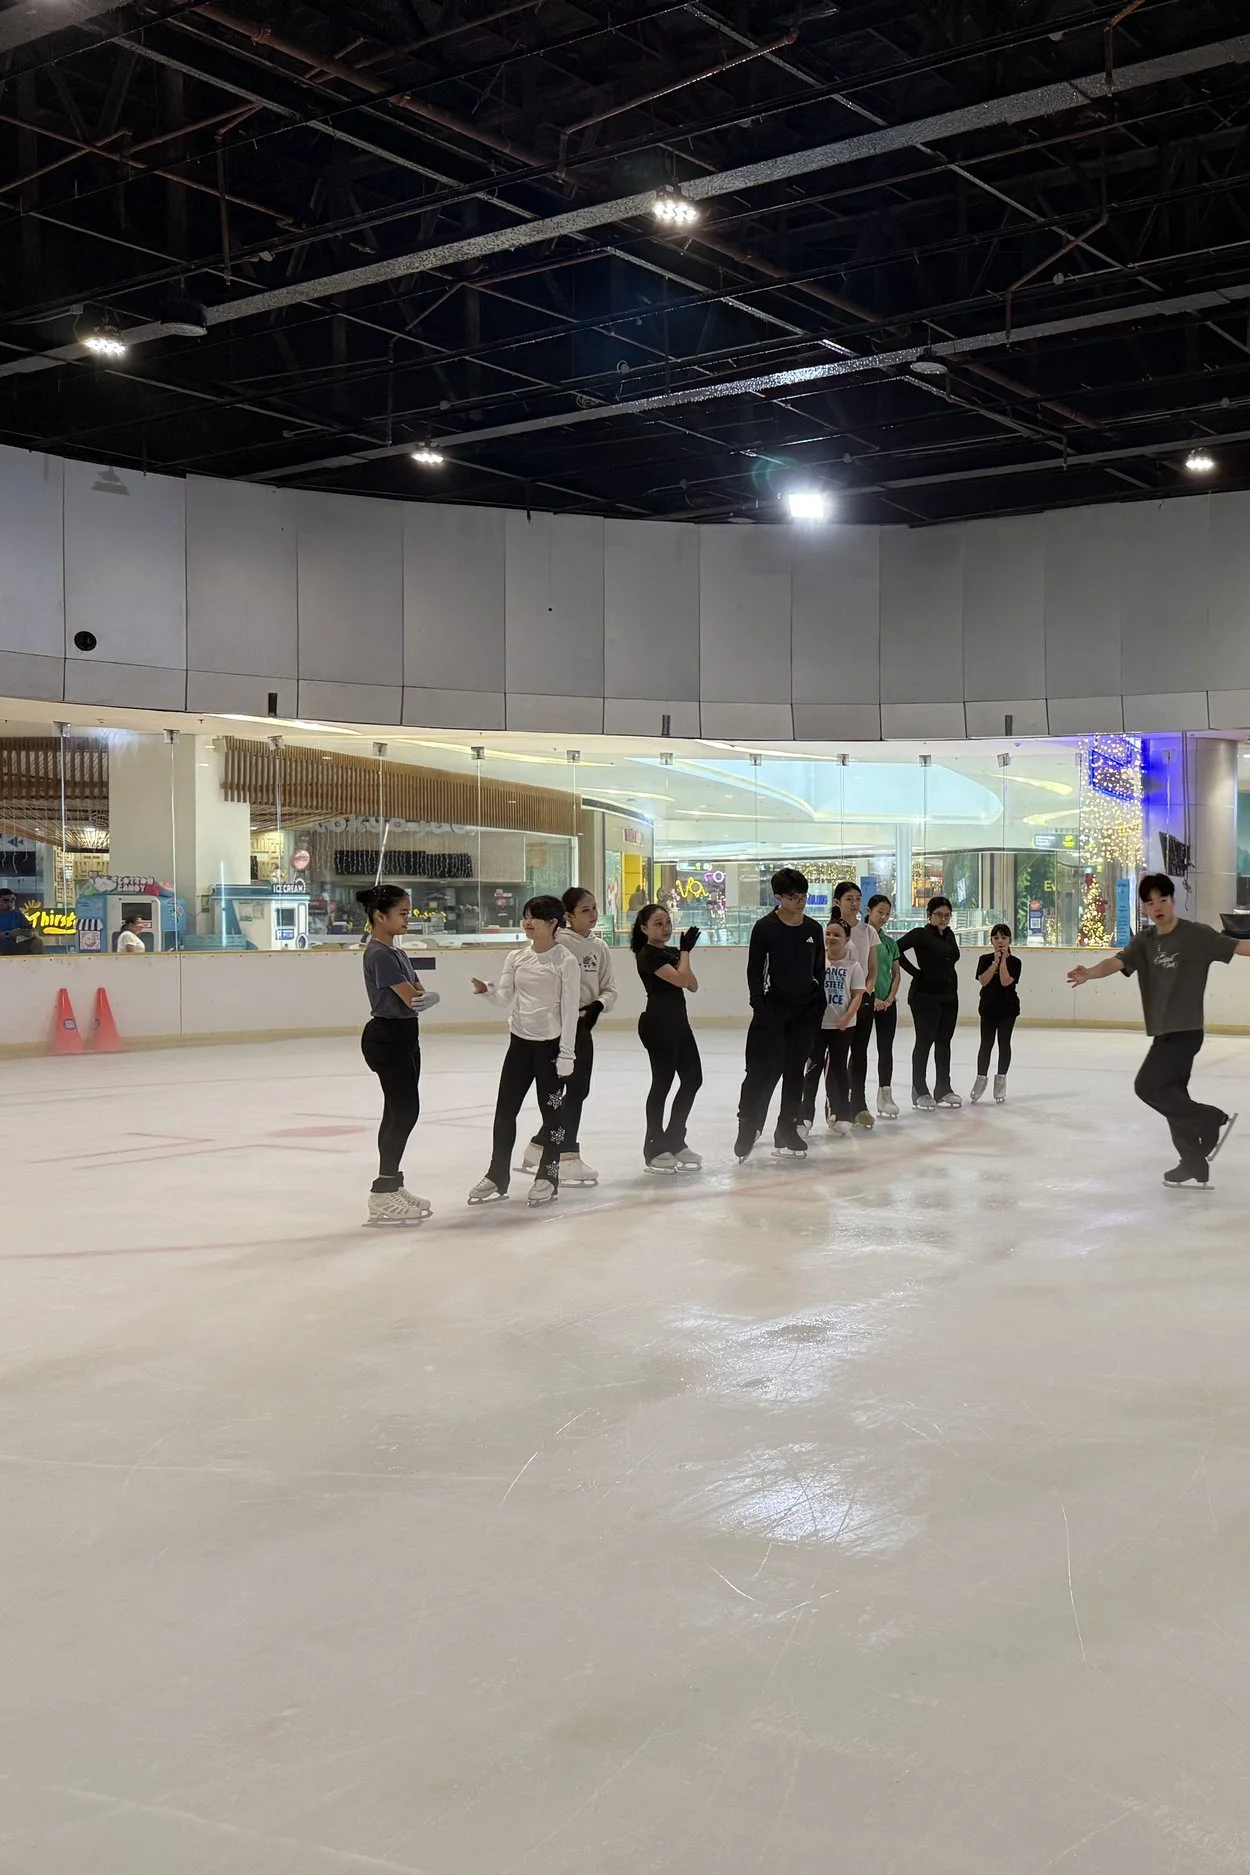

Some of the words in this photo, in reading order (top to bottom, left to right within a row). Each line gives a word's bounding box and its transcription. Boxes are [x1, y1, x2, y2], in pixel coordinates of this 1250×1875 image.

[273, 884, 283, 893] ICE
[283, 884, 304, 893] CREAM
[825, 967, 847, 977] ANCE
[824, 980, 844, 989] STEEL
[828, 994, 844, 1005] ICE
